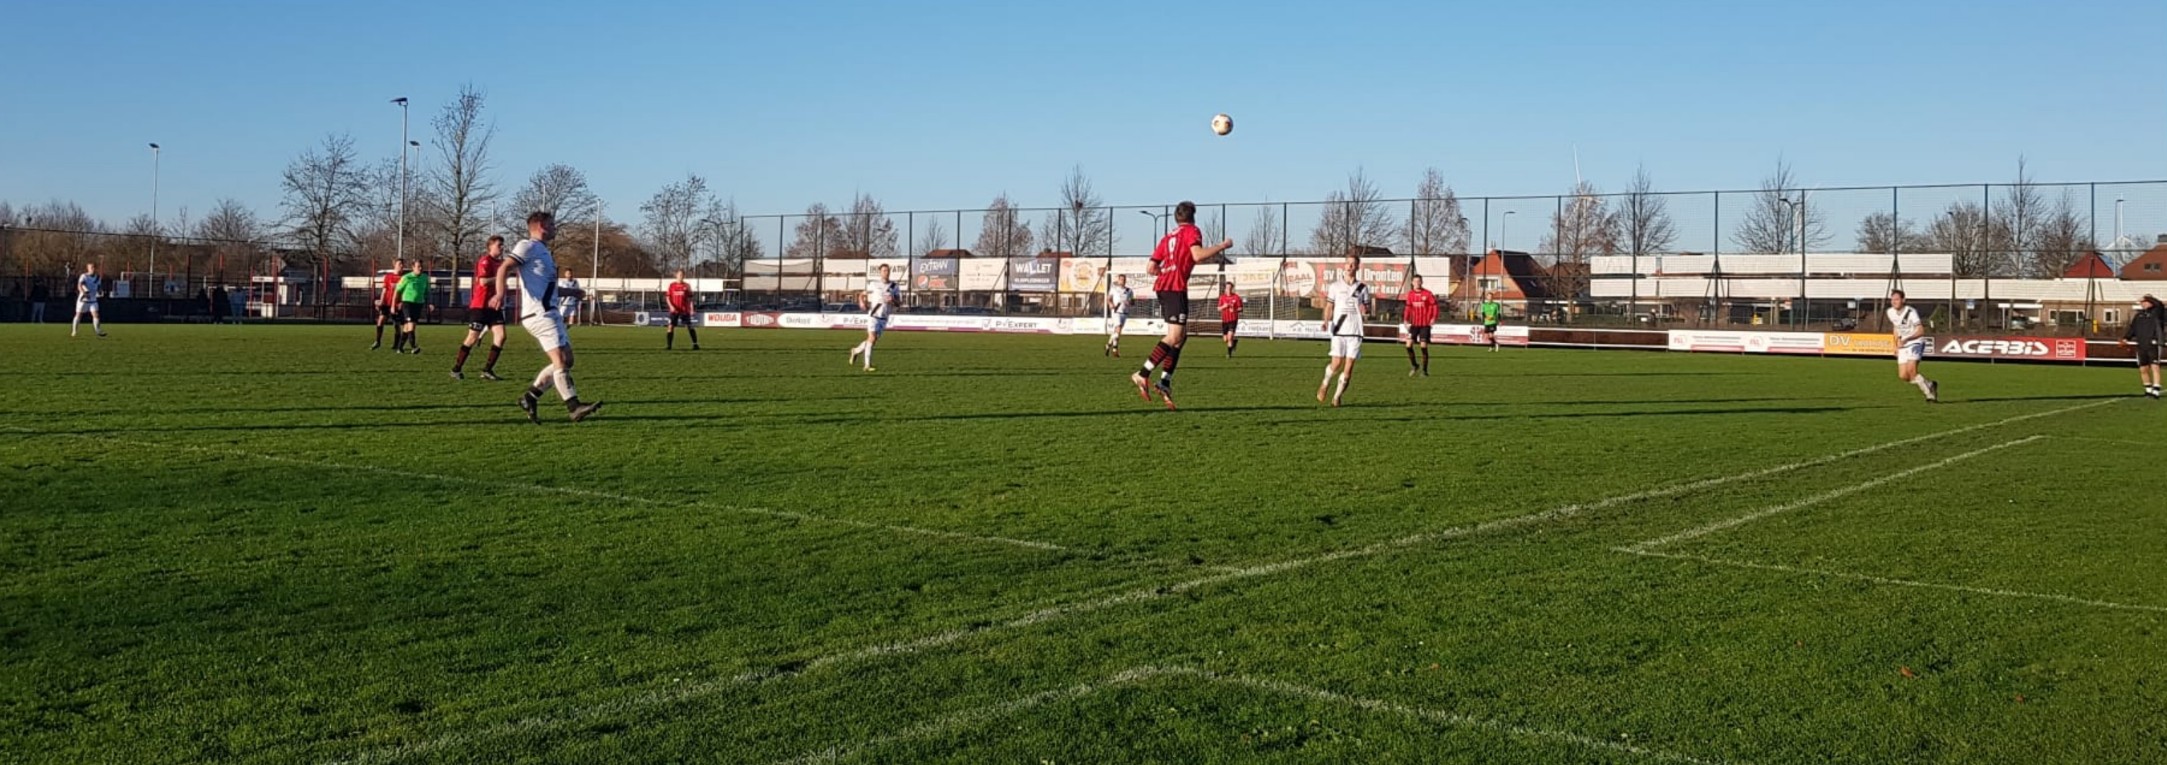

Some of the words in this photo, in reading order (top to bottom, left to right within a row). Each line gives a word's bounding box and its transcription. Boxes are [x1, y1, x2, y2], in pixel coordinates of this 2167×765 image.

[1014, 262, 1052, 275] WALLET
[1364, 268, 1404, 282] Dronten
[1829, 335, 1850, 346] DV
[1941, 339, 2050, 355] ACERBIS
